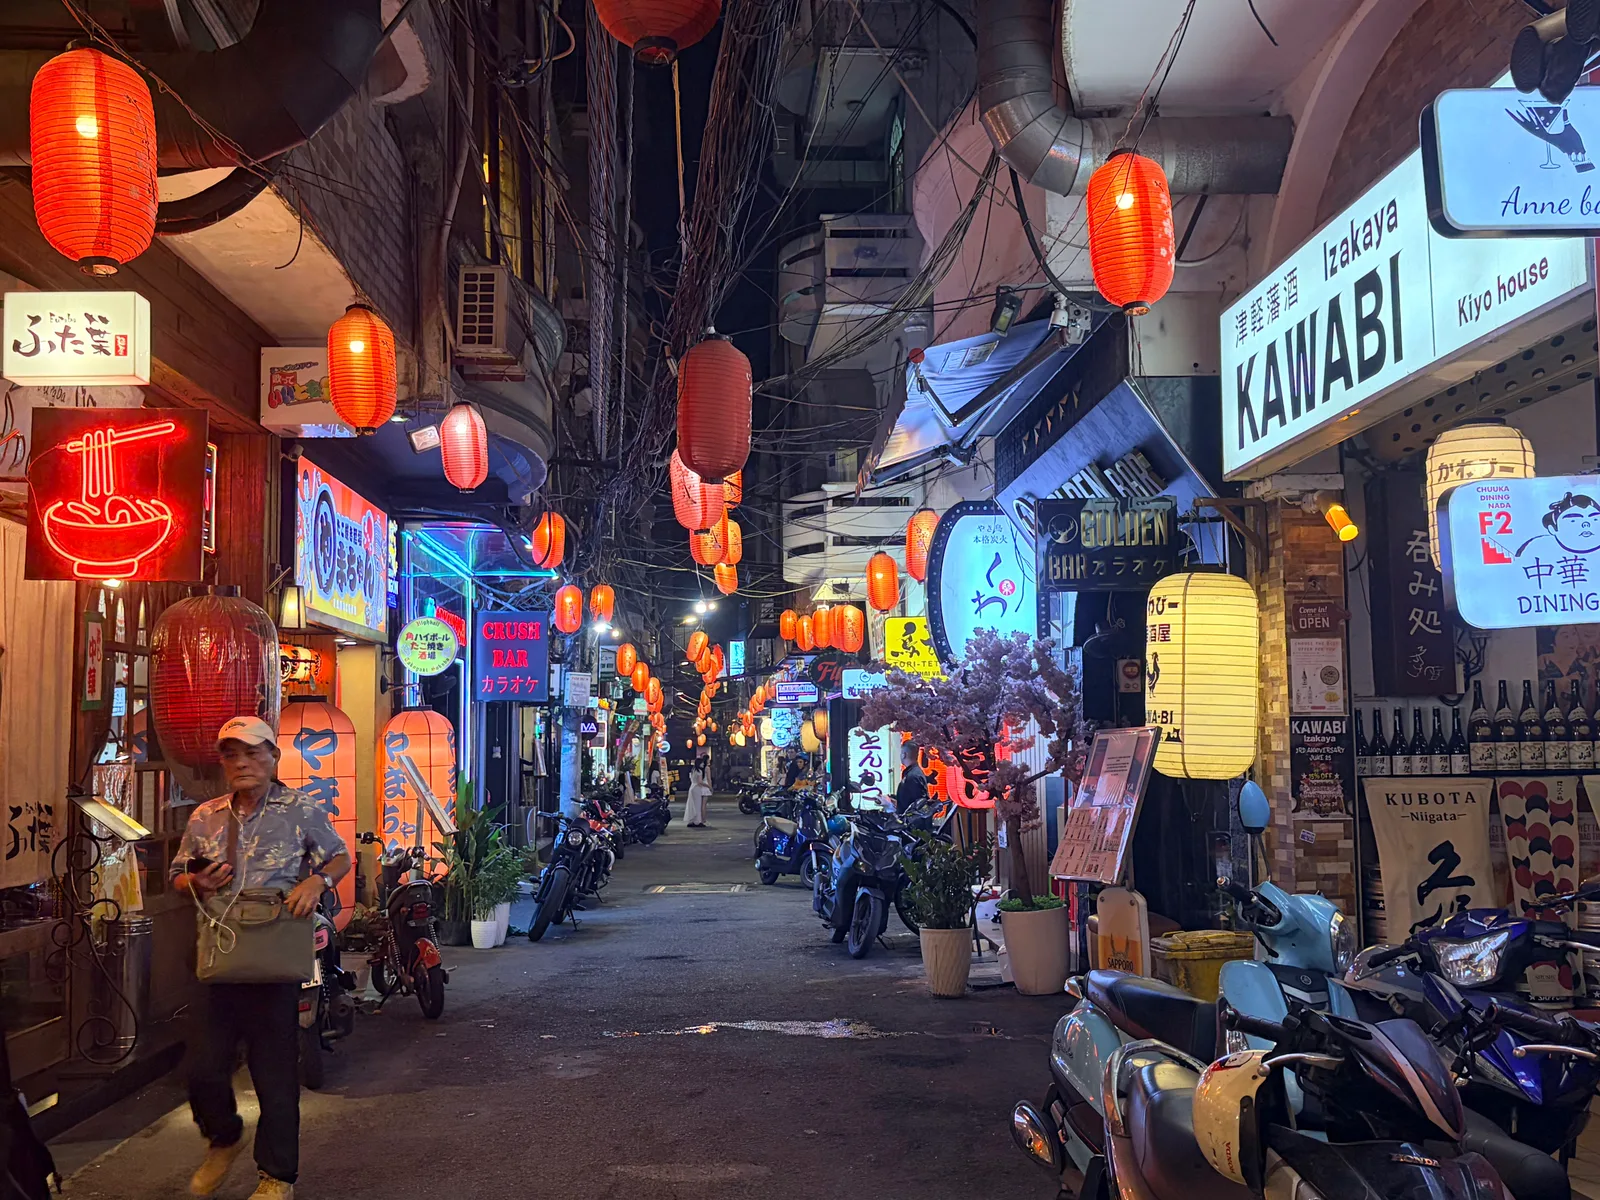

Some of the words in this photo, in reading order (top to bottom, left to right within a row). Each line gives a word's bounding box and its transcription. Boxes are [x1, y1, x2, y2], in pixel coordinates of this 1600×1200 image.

[1501, 185, 1573, 217] Anne
[1323, 197, 1399, 281] Izakaya
[1458, 291, 1493, 327] Kiyo
[1497, 256, 1549, 304] house
[1236, 248, 1404, 451] KAWABI
[1476, 486, 1510, 494] CHUUKA
[1080, 509, 1169, 548] GOLDEN
[1478, 511, 1513, 535] F2
[1048, 553, 1088, 580] BAR
[1092, 556, 1168, 576] カラオケ
[1522, 555, 1590, 590] 中華
[1517, 592, 1600, 614] DINING
[482, 622, 541, 640] CRUSH
[1299, 617, 1330, 629] OPEN
[492, 649, 528, 668] BAR
[482, 675, 539, 693] カラオケ
[1291, 720, 1346, 734] KAWABI
[1304, 735, 1336, 743] Izakaya
[1384, 791, 1477, 806] KUBOTA
[1409, 811, 1458, 824] Niigata
[1107, 957, 1134, 972] SAPPORO
